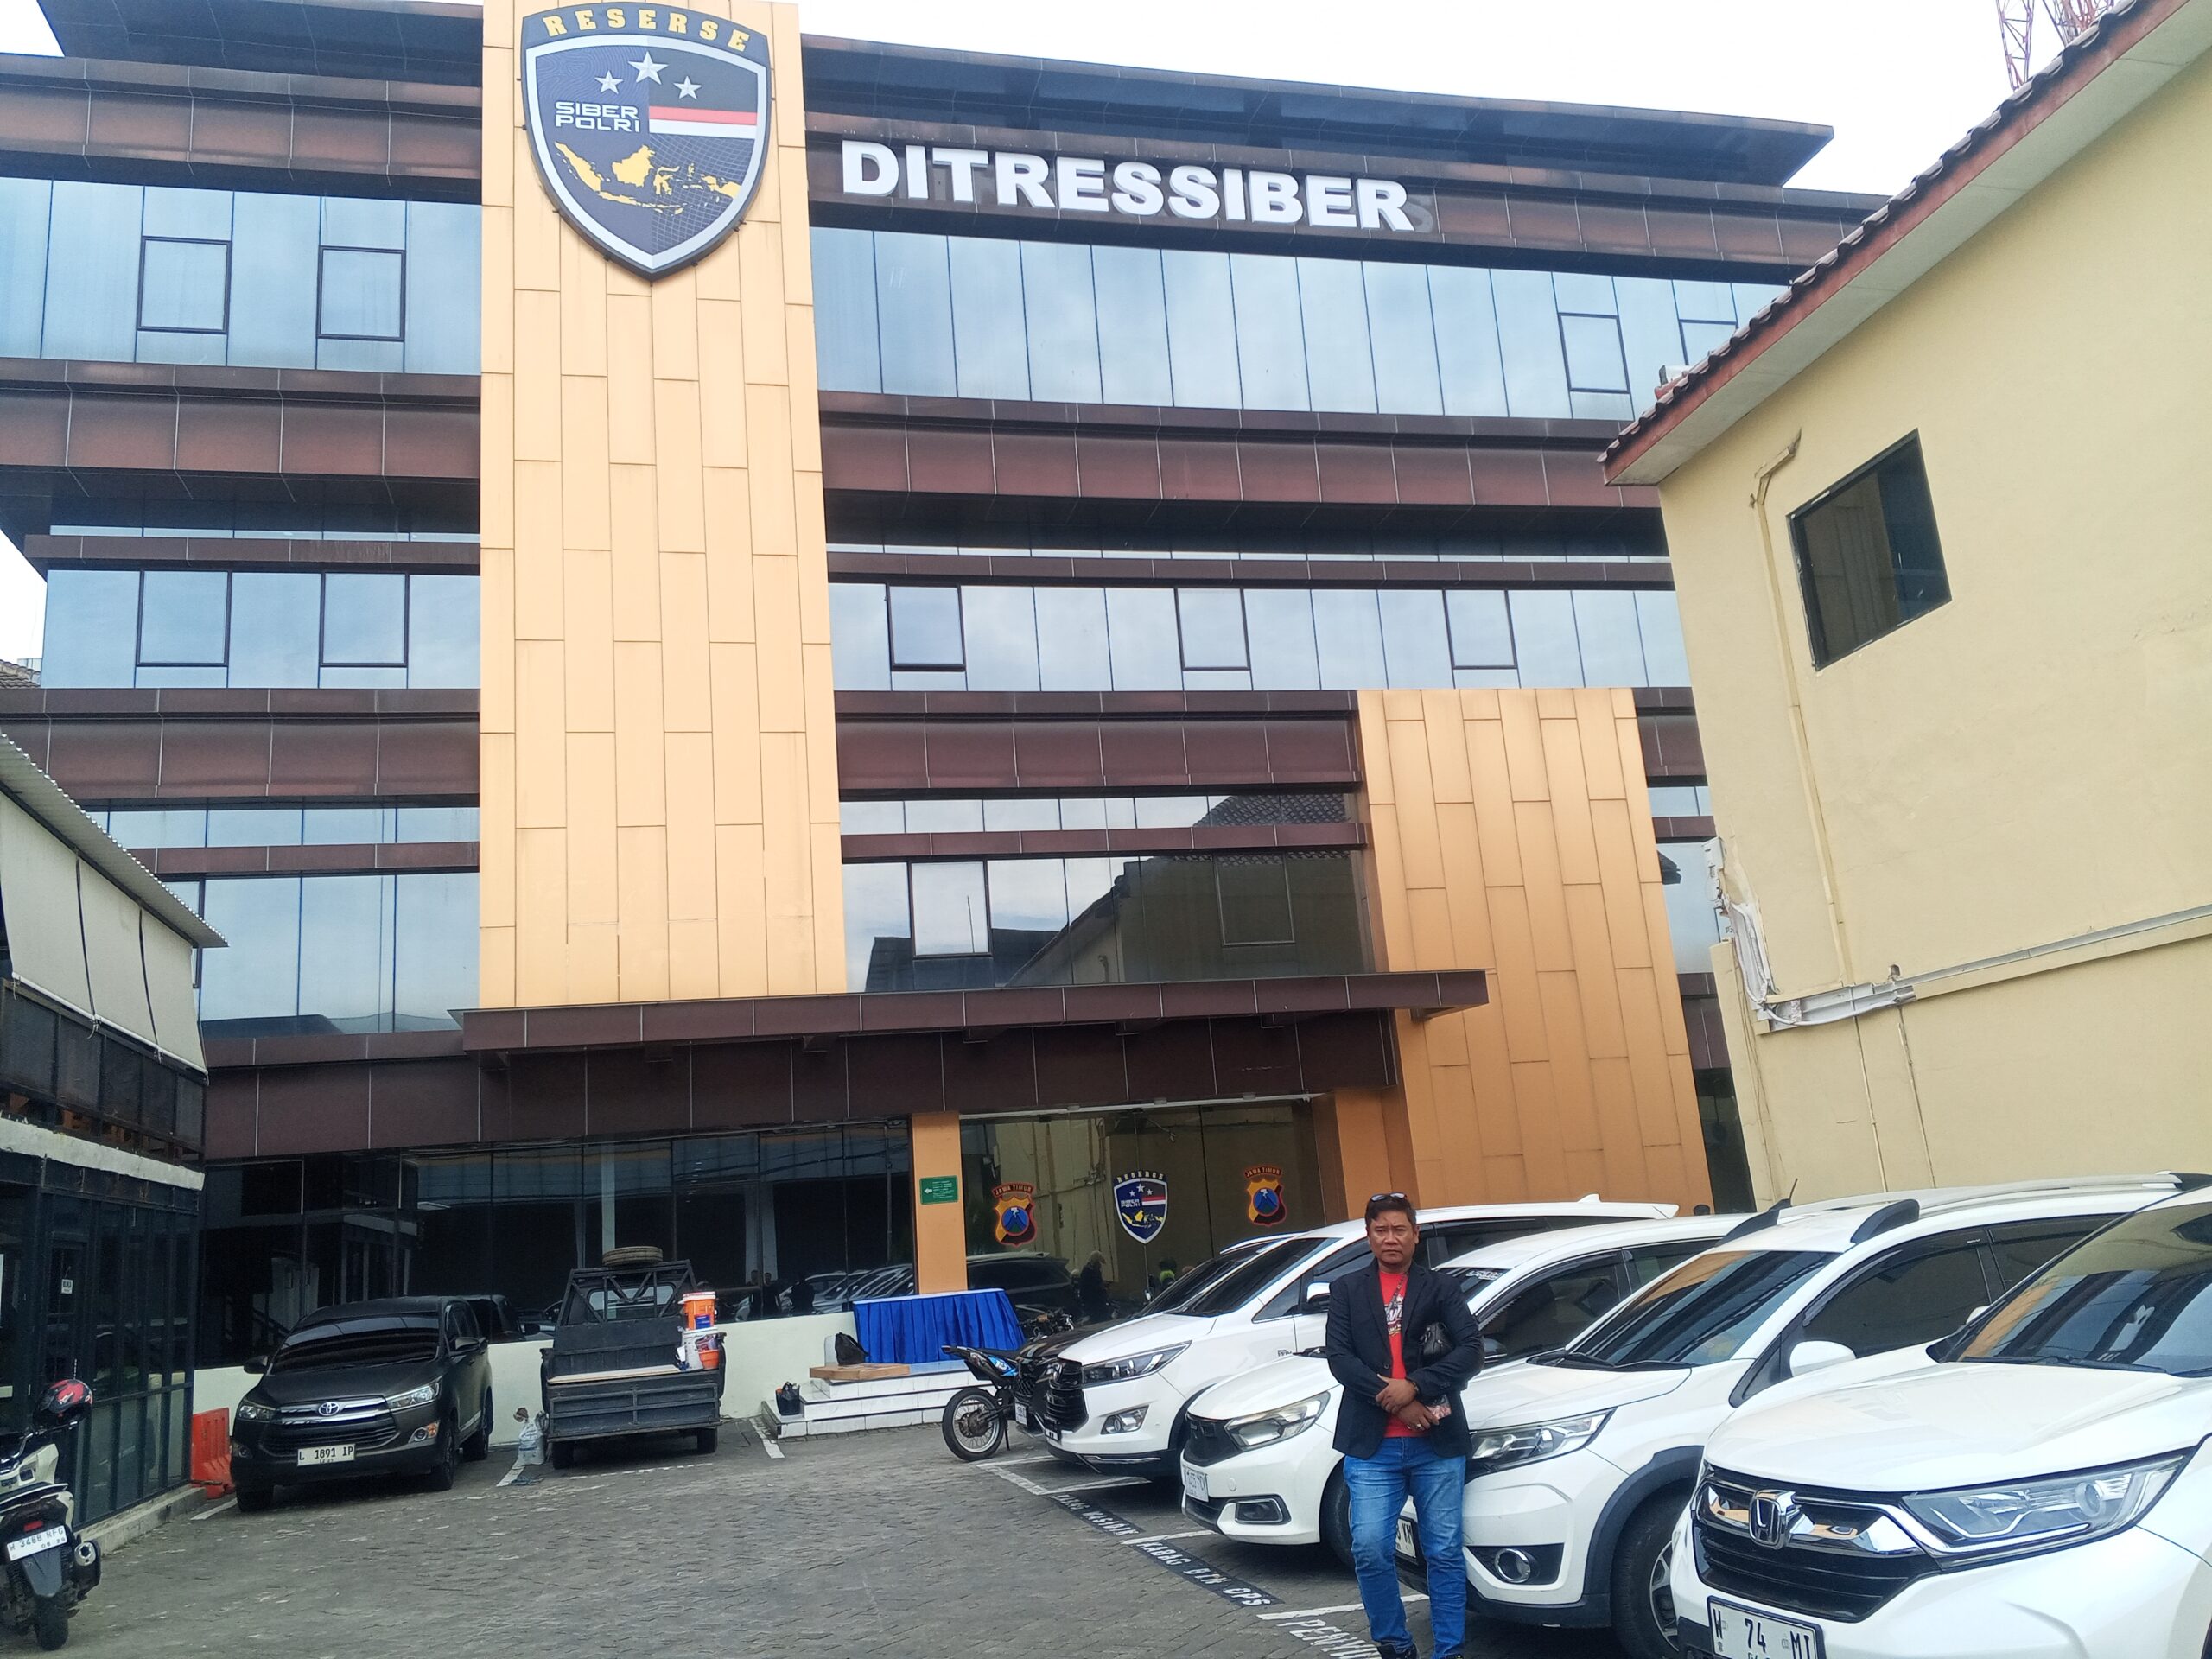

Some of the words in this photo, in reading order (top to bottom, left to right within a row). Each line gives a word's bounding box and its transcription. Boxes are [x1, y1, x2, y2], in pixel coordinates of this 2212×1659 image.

[543, 8, 749, 52] RESERSE
[555, 101, 639, 119] SIBER
[555, 114, 639, 132] POLRI
[841, 140, 1414, 232] DITRESSIBER
[1246, 1167, 1261, 1177] JAWA
[1262, 1166, 1280, 1175] TIMUR
[995, 1185, 1011, 1195] JAWA
[299, 1451, 305, 1460] L
[314, 1447, 336, 1459] 1891
[342, 1446, 353, 1456] IP
[1135, 1542, 1192, 1566] KABAG
[1223, 1587, 1271, 1606] OPS
[1713, 1608, 1723, 1639] W
[1744, 1618, 1766, 1654] 74
